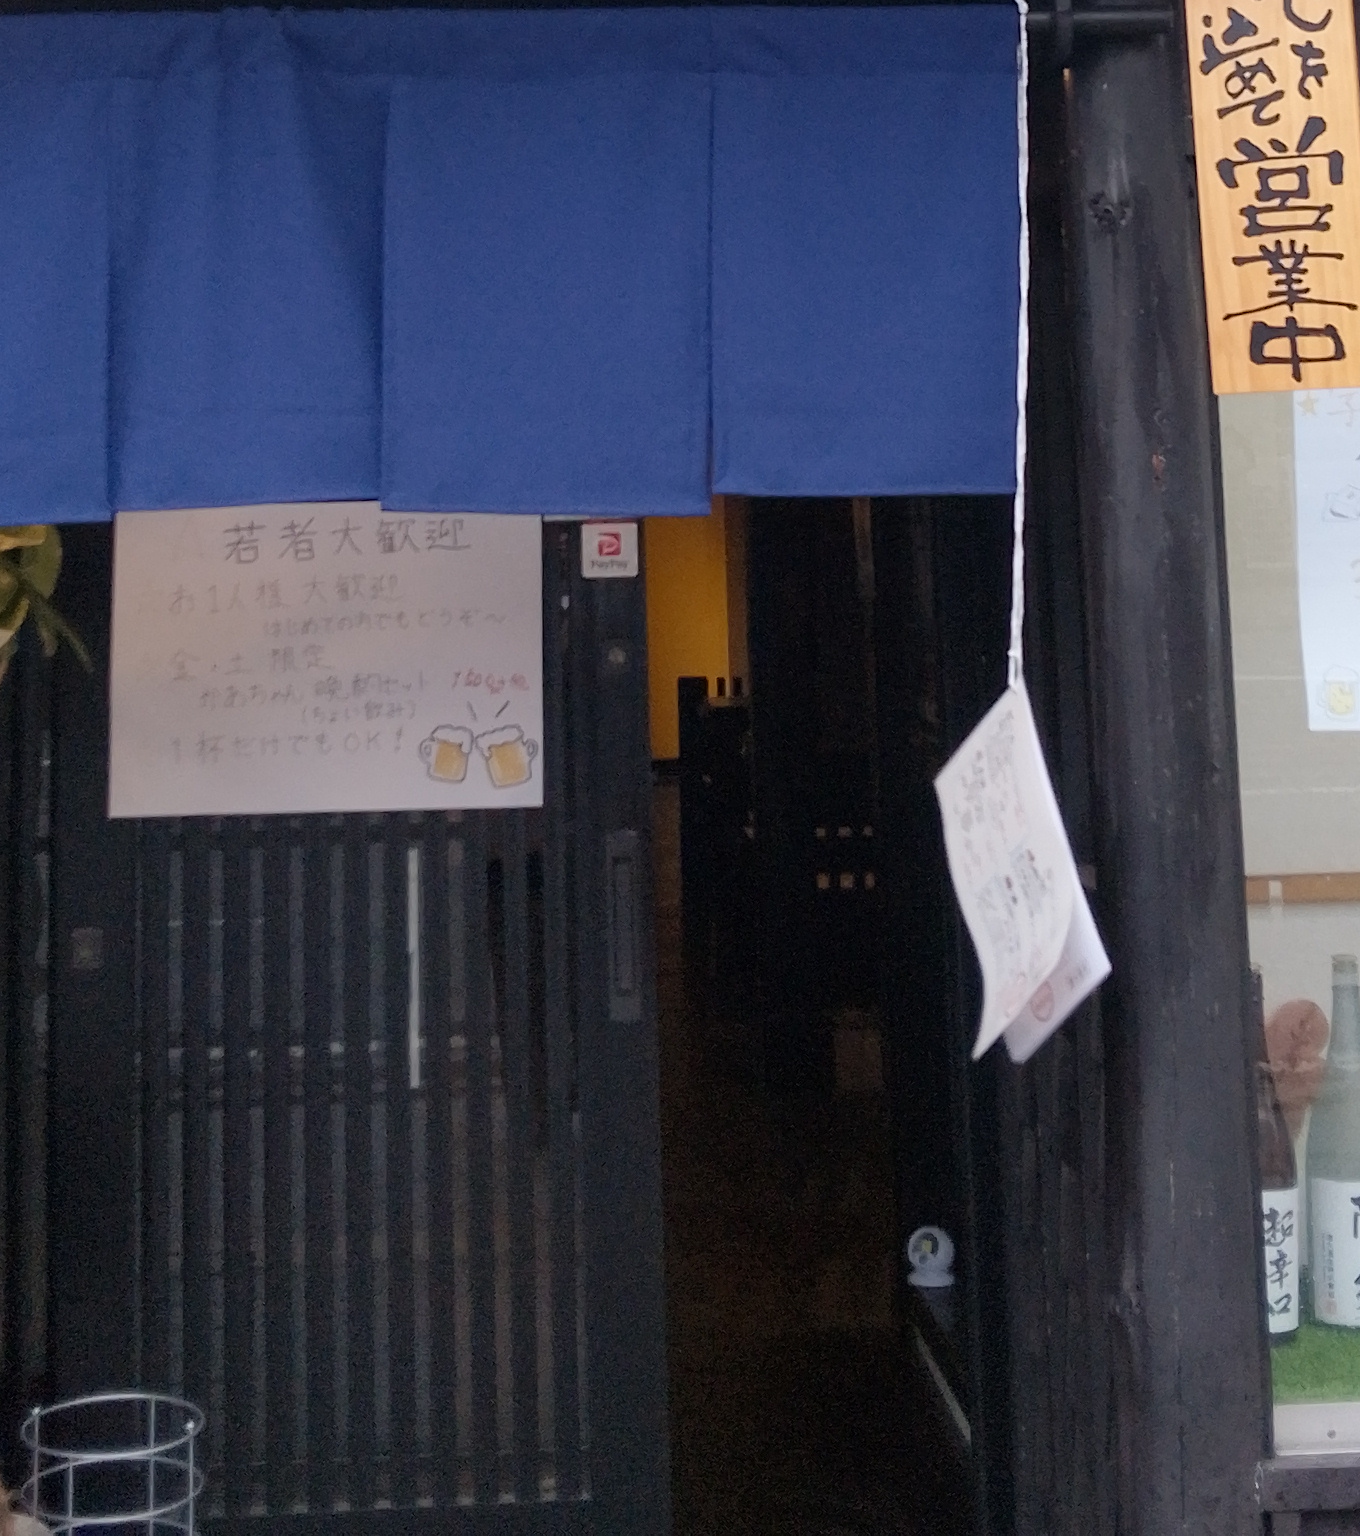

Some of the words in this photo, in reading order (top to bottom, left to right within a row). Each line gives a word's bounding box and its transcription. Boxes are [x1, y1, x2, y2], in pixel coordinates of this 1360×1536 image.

[1216, 116, 1358, 383] 営業中
[222, 515, 472, 565] 若者大歓迎
